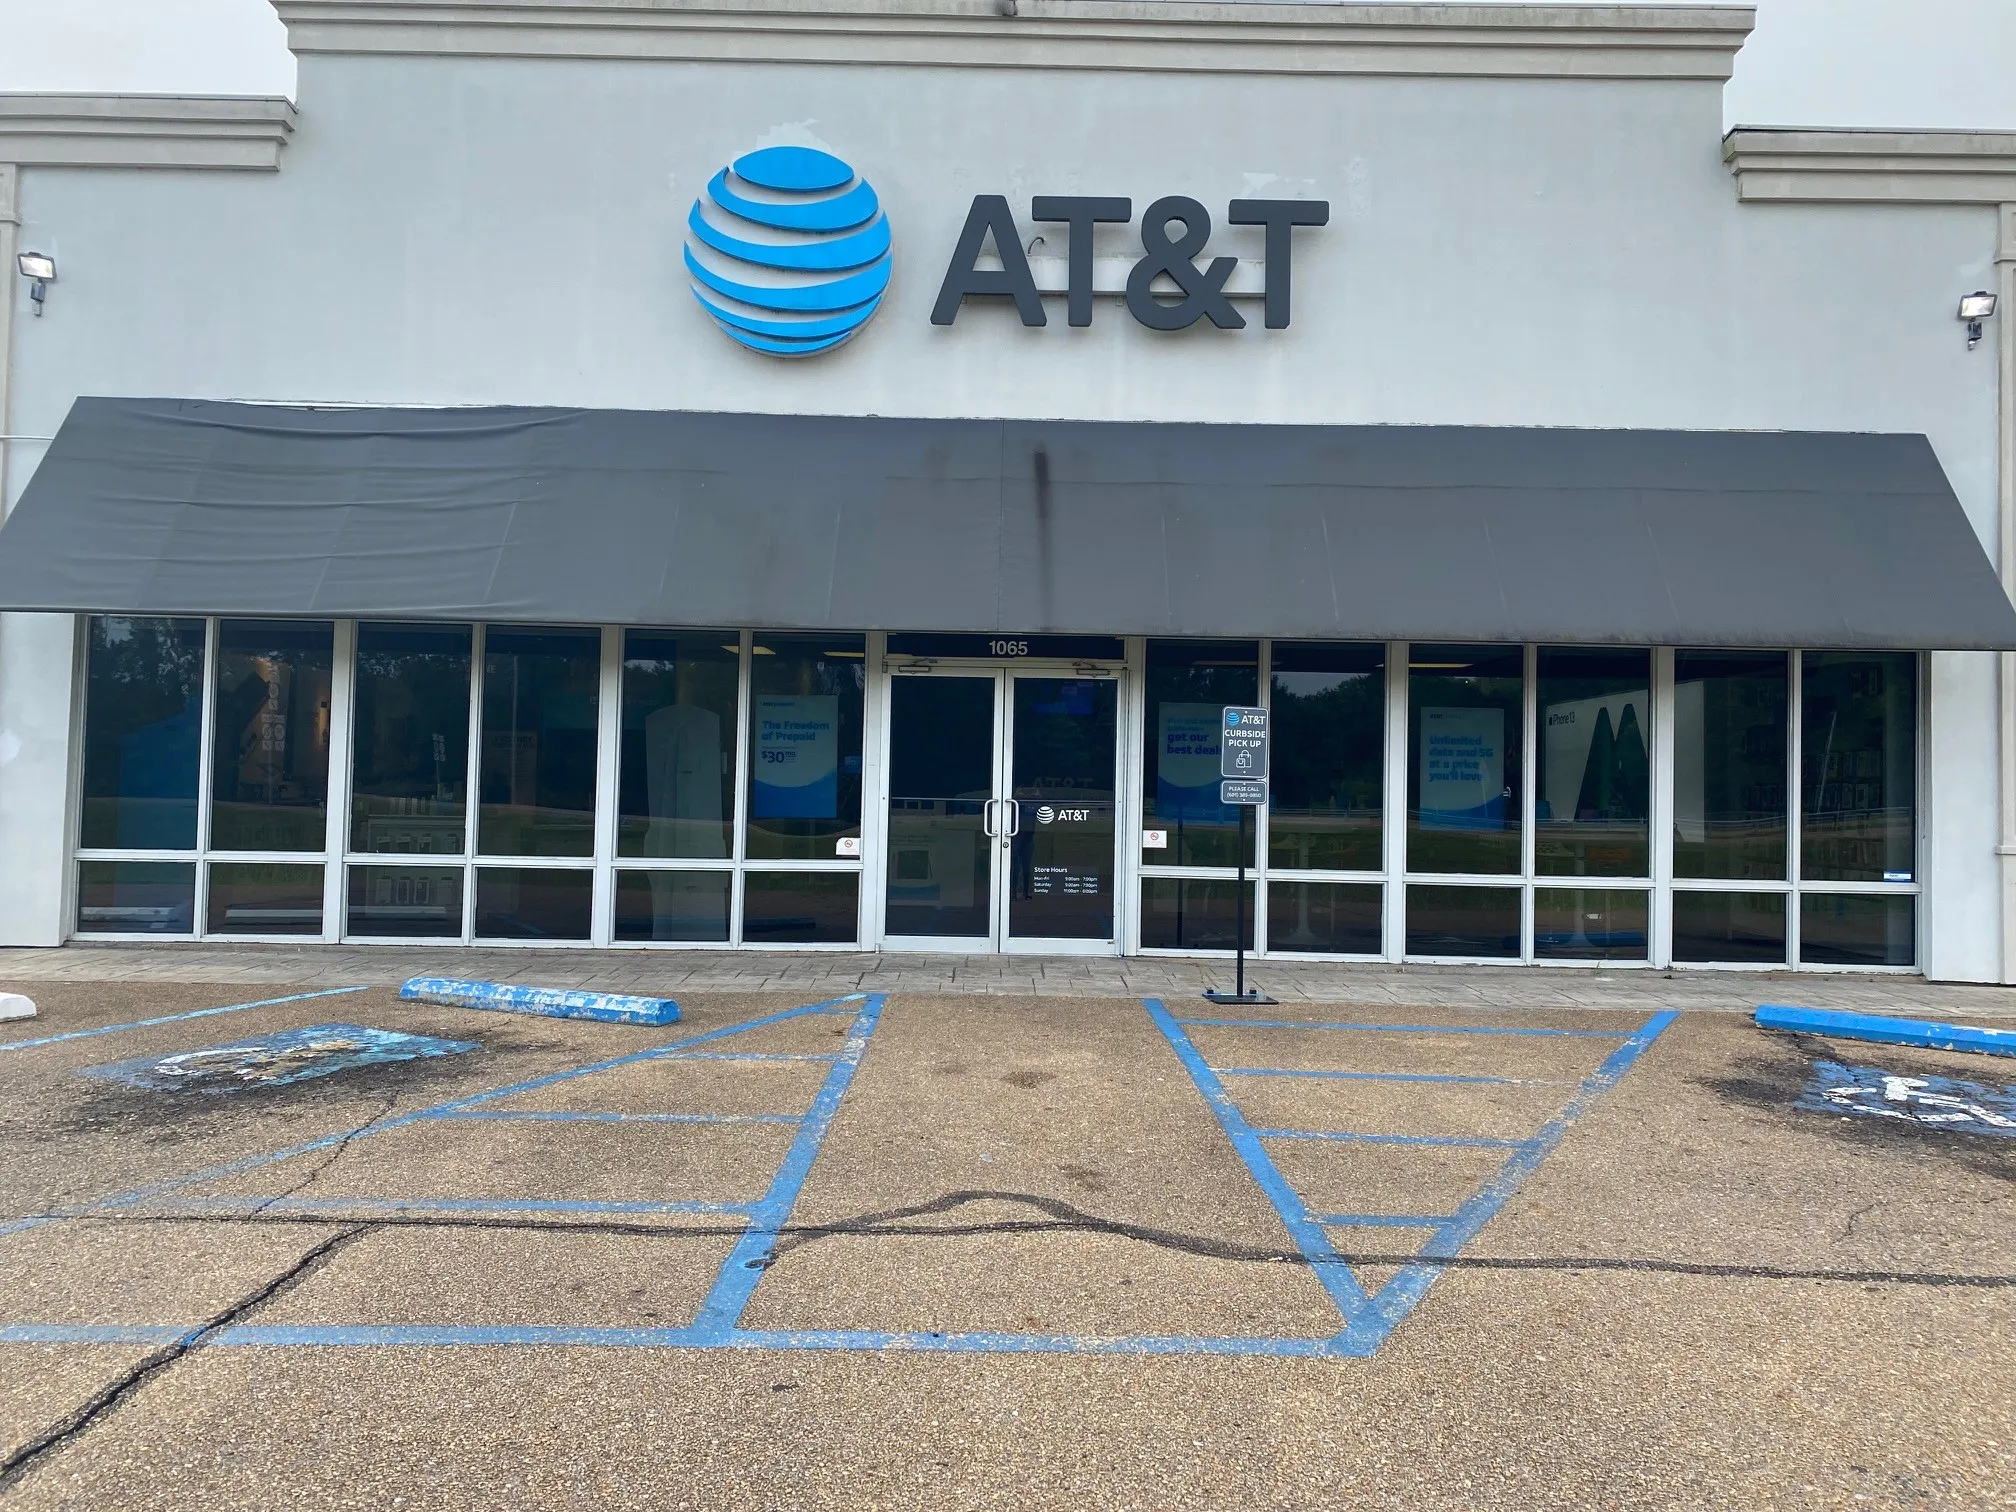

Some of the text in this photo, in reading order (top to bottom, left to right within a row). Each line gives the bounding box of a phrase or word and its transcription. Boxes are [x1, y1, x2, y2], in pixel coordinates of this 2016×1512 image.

[930, 194, 1330, 331] AT&T
[989, 640, 1028, 656] 1065
[762, 720, 829, 730] The Freedom
[1241, 715, 1266, 725] AT&T
[761, 732, 816, 742] of Prepaid
[1167, 733, 1209, 743] get our
[1224, 729, 1266, 739] CURBSIDE
[1228, 739, 1262, 748] PICK UP
[1429, 734, 1482, 745] Unlimited
[1167, 744, 1192, 754] best
[1429, 747, 1494, 757] data and 5G
[761, 751, 785, 763] $30
[1429, 760, 1441, 768] at
[1452, 759, 1480, 771] price
[1429, 771, 1482, 782] you'll love
[1057, 809, 1090, 821] AT&T
